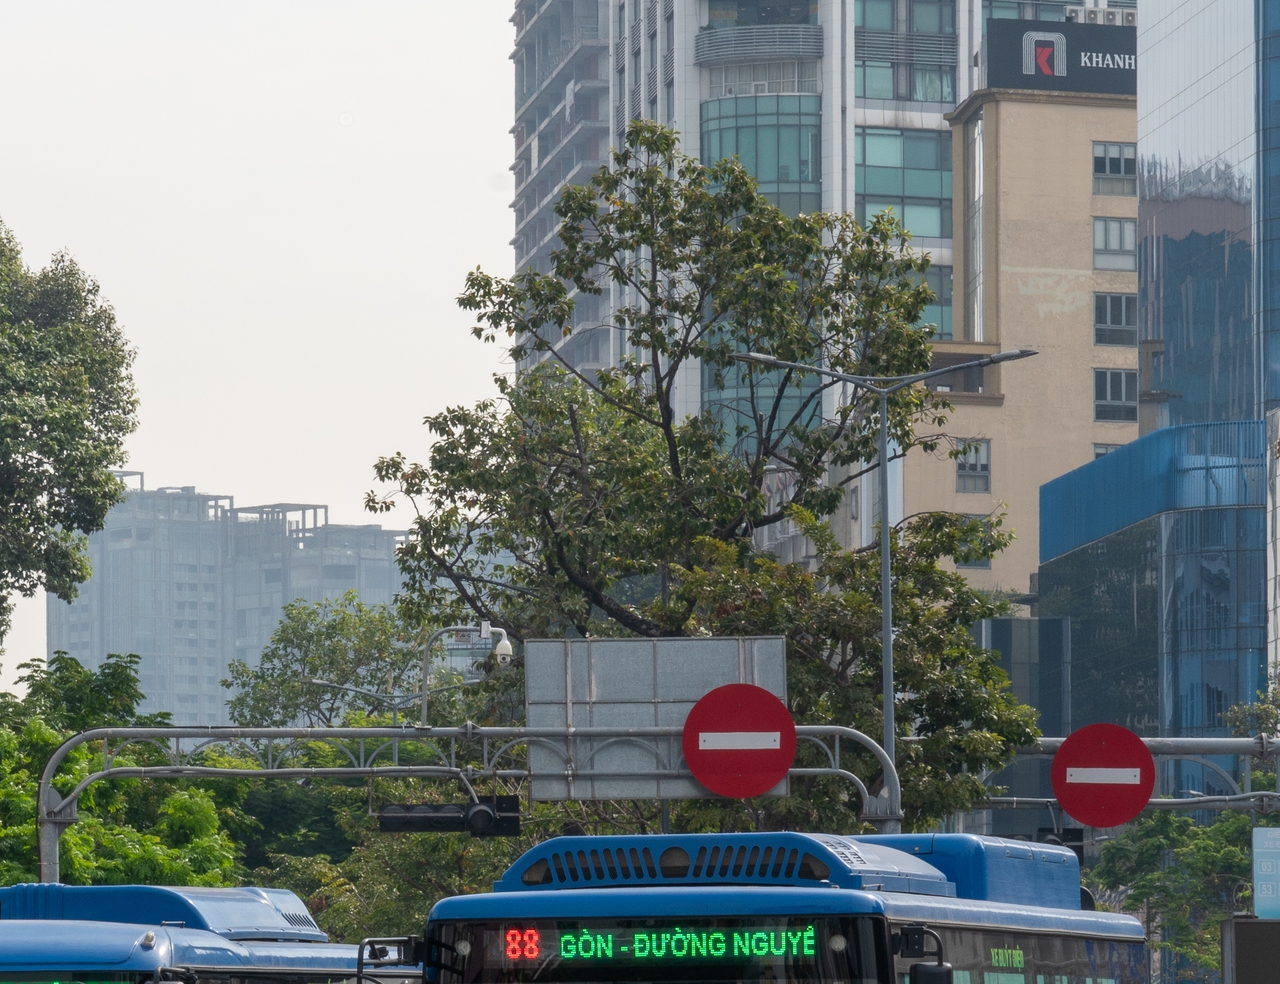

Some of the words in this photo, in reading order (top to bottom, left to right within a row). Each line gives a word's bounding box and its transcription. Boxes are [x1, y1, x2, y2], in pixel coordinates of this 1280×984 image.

[1080, 52, 1136, 70] KHANH
[1261, 861, 1272, 872] 03
[1262, 884, 1272, 895] 53
[506, 929, 540, 959] 88
[561, 929, 613, 958] GÒN
[634, 928, 726, 958] ĐƯỜNG
